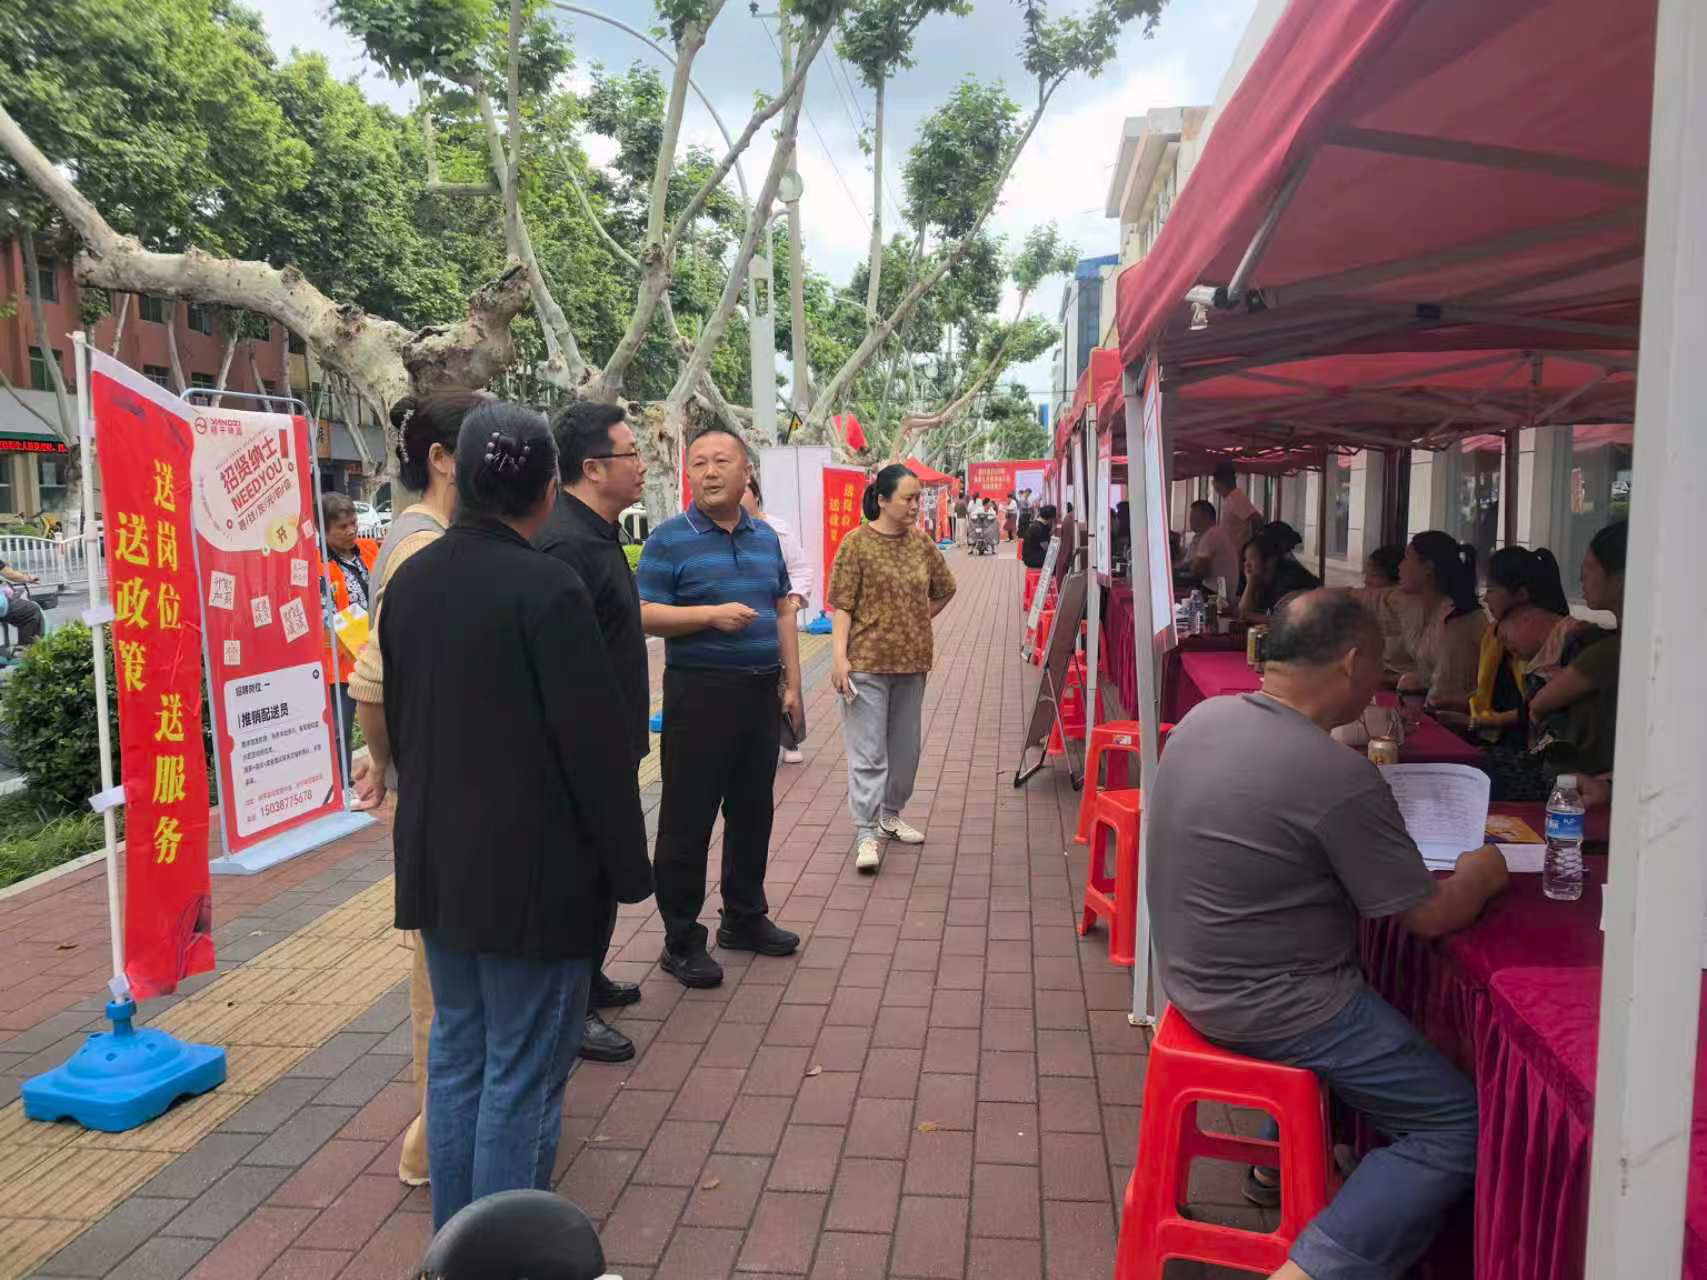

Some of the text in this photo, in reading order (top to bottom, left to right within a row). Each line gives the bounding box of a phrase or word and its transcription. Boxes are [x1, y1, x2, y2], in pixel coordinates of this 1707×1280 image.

[220, 436, 277, 494] 招贤纳士
[231, 458, 282, 511] NEEDYOU
[114, 512, 150, 691] 送政策
[153, 459, 187, 866] 送岗位 送服务
[241, 702, 289, 728] 推销配送员
